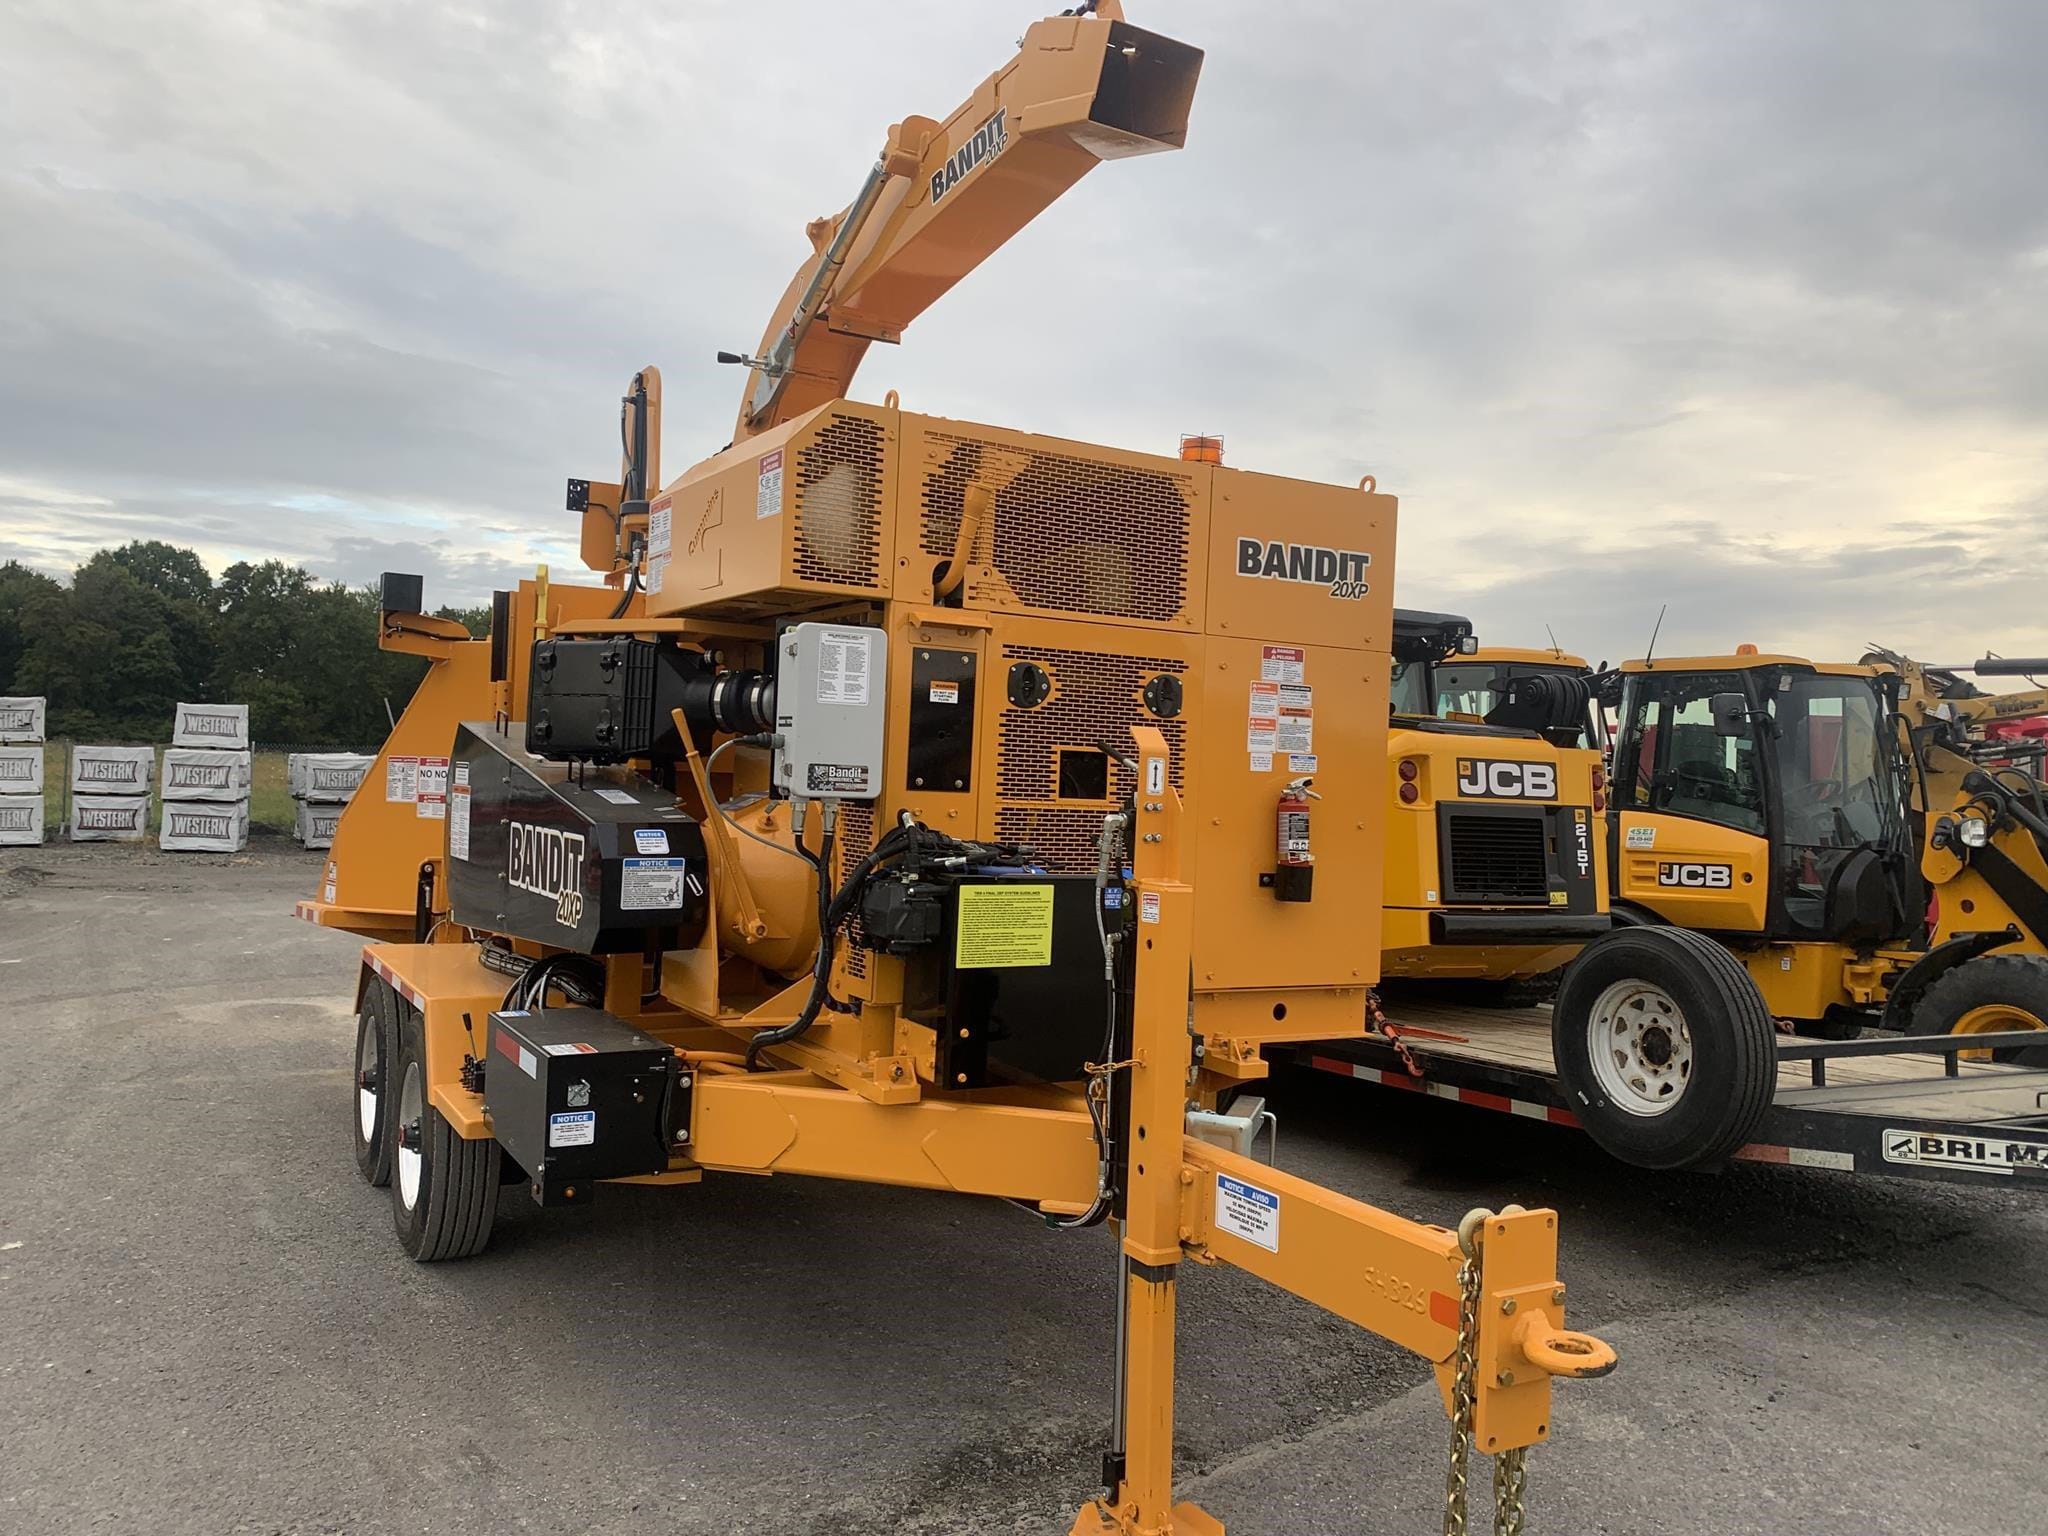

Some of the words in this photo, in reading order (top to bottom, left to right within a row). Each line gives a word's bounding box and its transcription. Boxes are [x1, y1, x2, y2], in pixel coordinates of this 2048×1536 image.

[931, 105, 1007, 206] BANDIT
[984, 132, 1008, 168] 20XP
[1237, 537, 1371, 584] BANDIT
[1330, 580, 1369, 600] 20XP
[188, 715, 236, 734] WESTERN
[83, 761, 133, 780] WESTERN
[174, 766, 227, 786] WESTERN
[420, 770, 432, 778] NO
[829, 766, 862, 778] Bandit
[1459, 761, 1556, 798] JCB
[82, 810, 133, 828] WESTERN
[174, 815, 227, 836] WESTERN
[1574, 823, 1590, 876] 215T
[509, 822, 585, 900] BANDIT
[1660, 865, 1731, 887] JCB
[556, 890, 583, 928] 20XP
[557, 1114, 589, 1123] NOTICE
[1224, 1180, 1245, 1195] NOTICE
[1252, 1191, 1269, 1204] AVISO
[1224, 1191, 1242, 1201] MAXIMUM
[1243, 1198, 1258, 1208] TOWING
[1258, 1203, 1271, 1213] SPEED
[1226, 1206, 1246, 1218] VELOCIDAD
